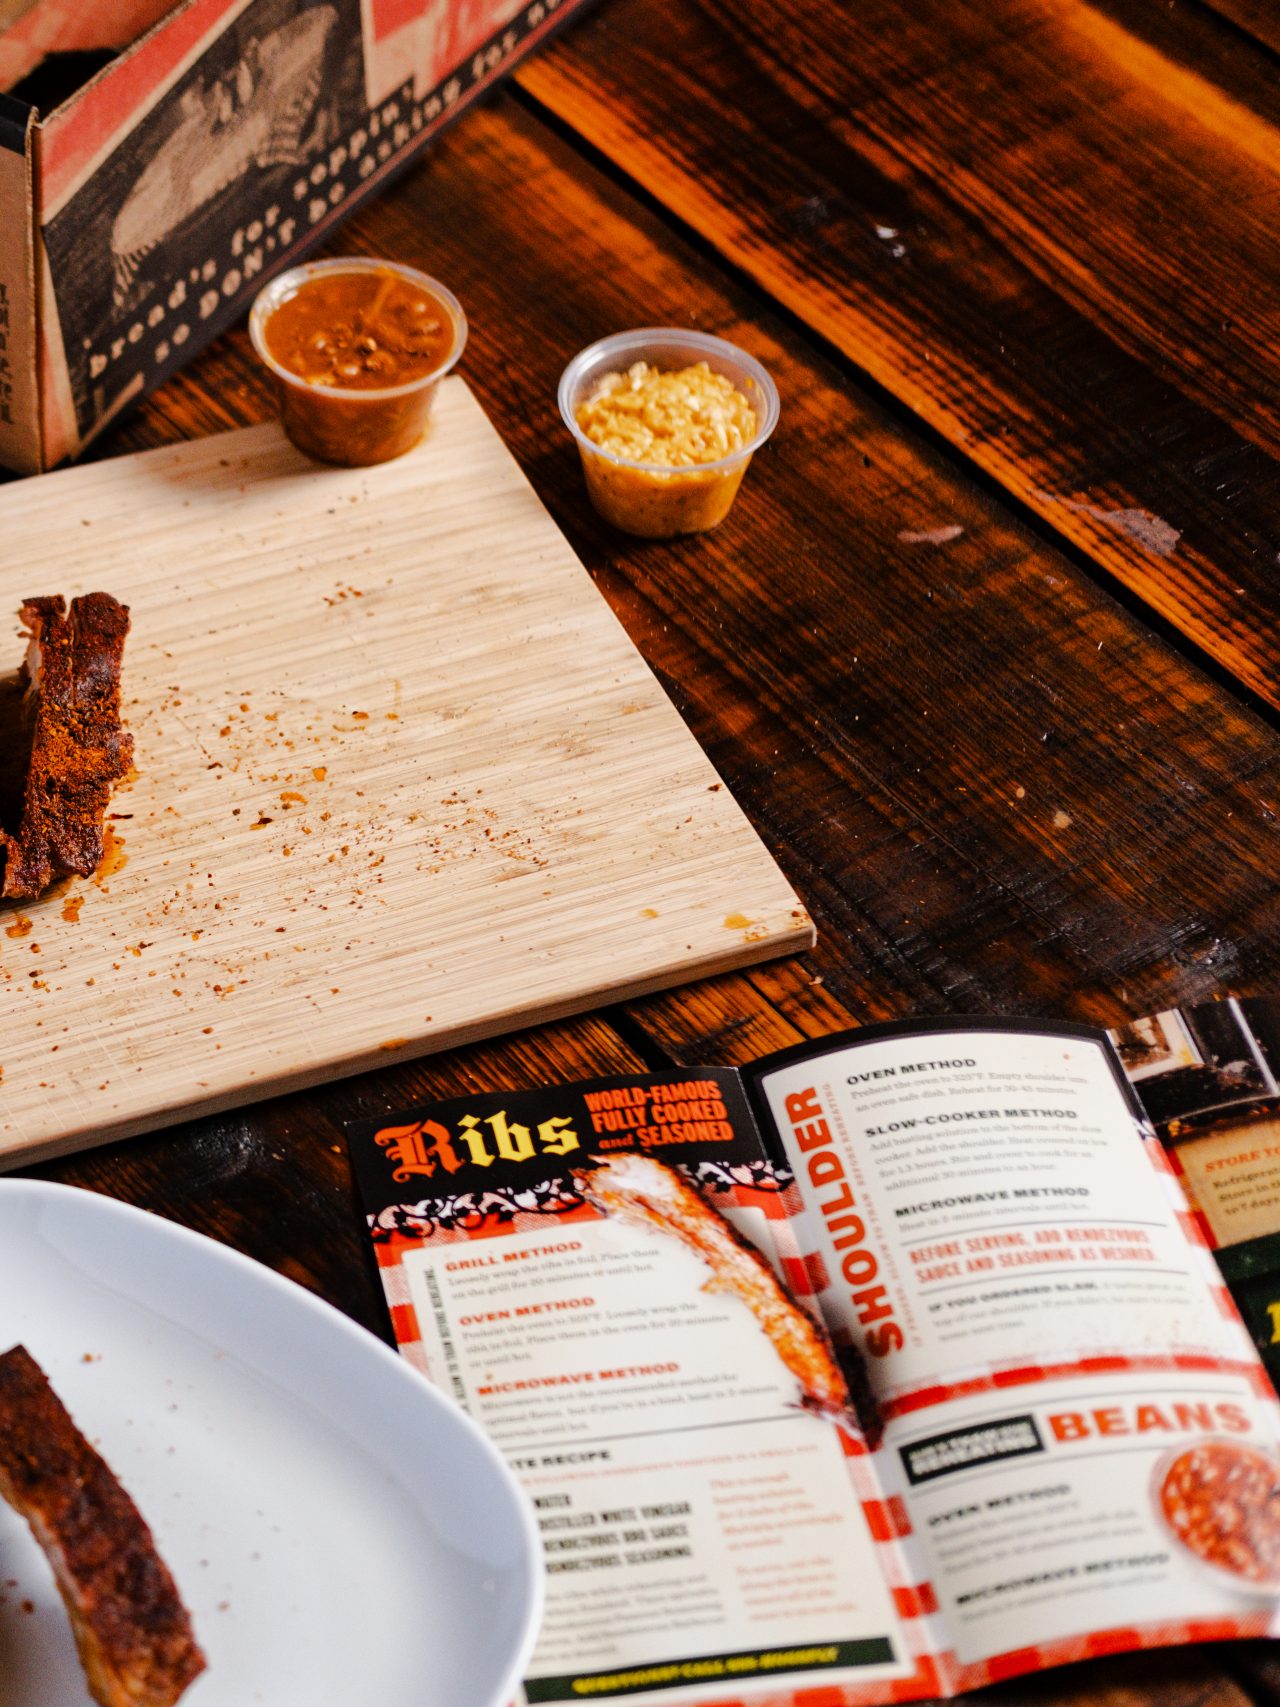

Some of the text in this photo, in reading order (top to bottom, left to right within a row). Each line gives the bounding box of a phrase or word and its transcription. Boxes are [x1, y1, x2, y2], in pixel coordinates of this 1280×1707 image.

[231, 205, 280, 257] for
[846, 1058, 977, 1085] OVEN METHOD
[583, 1079, 723, 1113] WORLD-FAMOUS
[590, 1099, 729, 1134] FULLY COOKED
[865, 1108, 1077, 1137] SLOW-COOKER METHOD
[373, 1110, 581, 1184] Ribs
[598, 1120, 735, 1150] and SEASONED
[1205, 1150, 1260, 1173] STORE
[893, 1187, 1089, 1217] MICROWAVE METHOD
[784, 1086, 904, 1357] SHOULDER
[444, 1242, 583, 1272] GRILL METHOD
[908, 1227, 1149, 1264] BEFORE SERVING, ADD RENDEZVOUS
[914, 1246, 1161, 1282] SAUCE AND SEASONING AS DESIRED.
[458, 1297, 596, 1325] OVEN METHOD
[476, 1363, 681, 1395] MICROWAVE METHOD
[1047, 1402, 1253, 1444] BEANS
[541, 1450, 610, 1465] RECIPE
